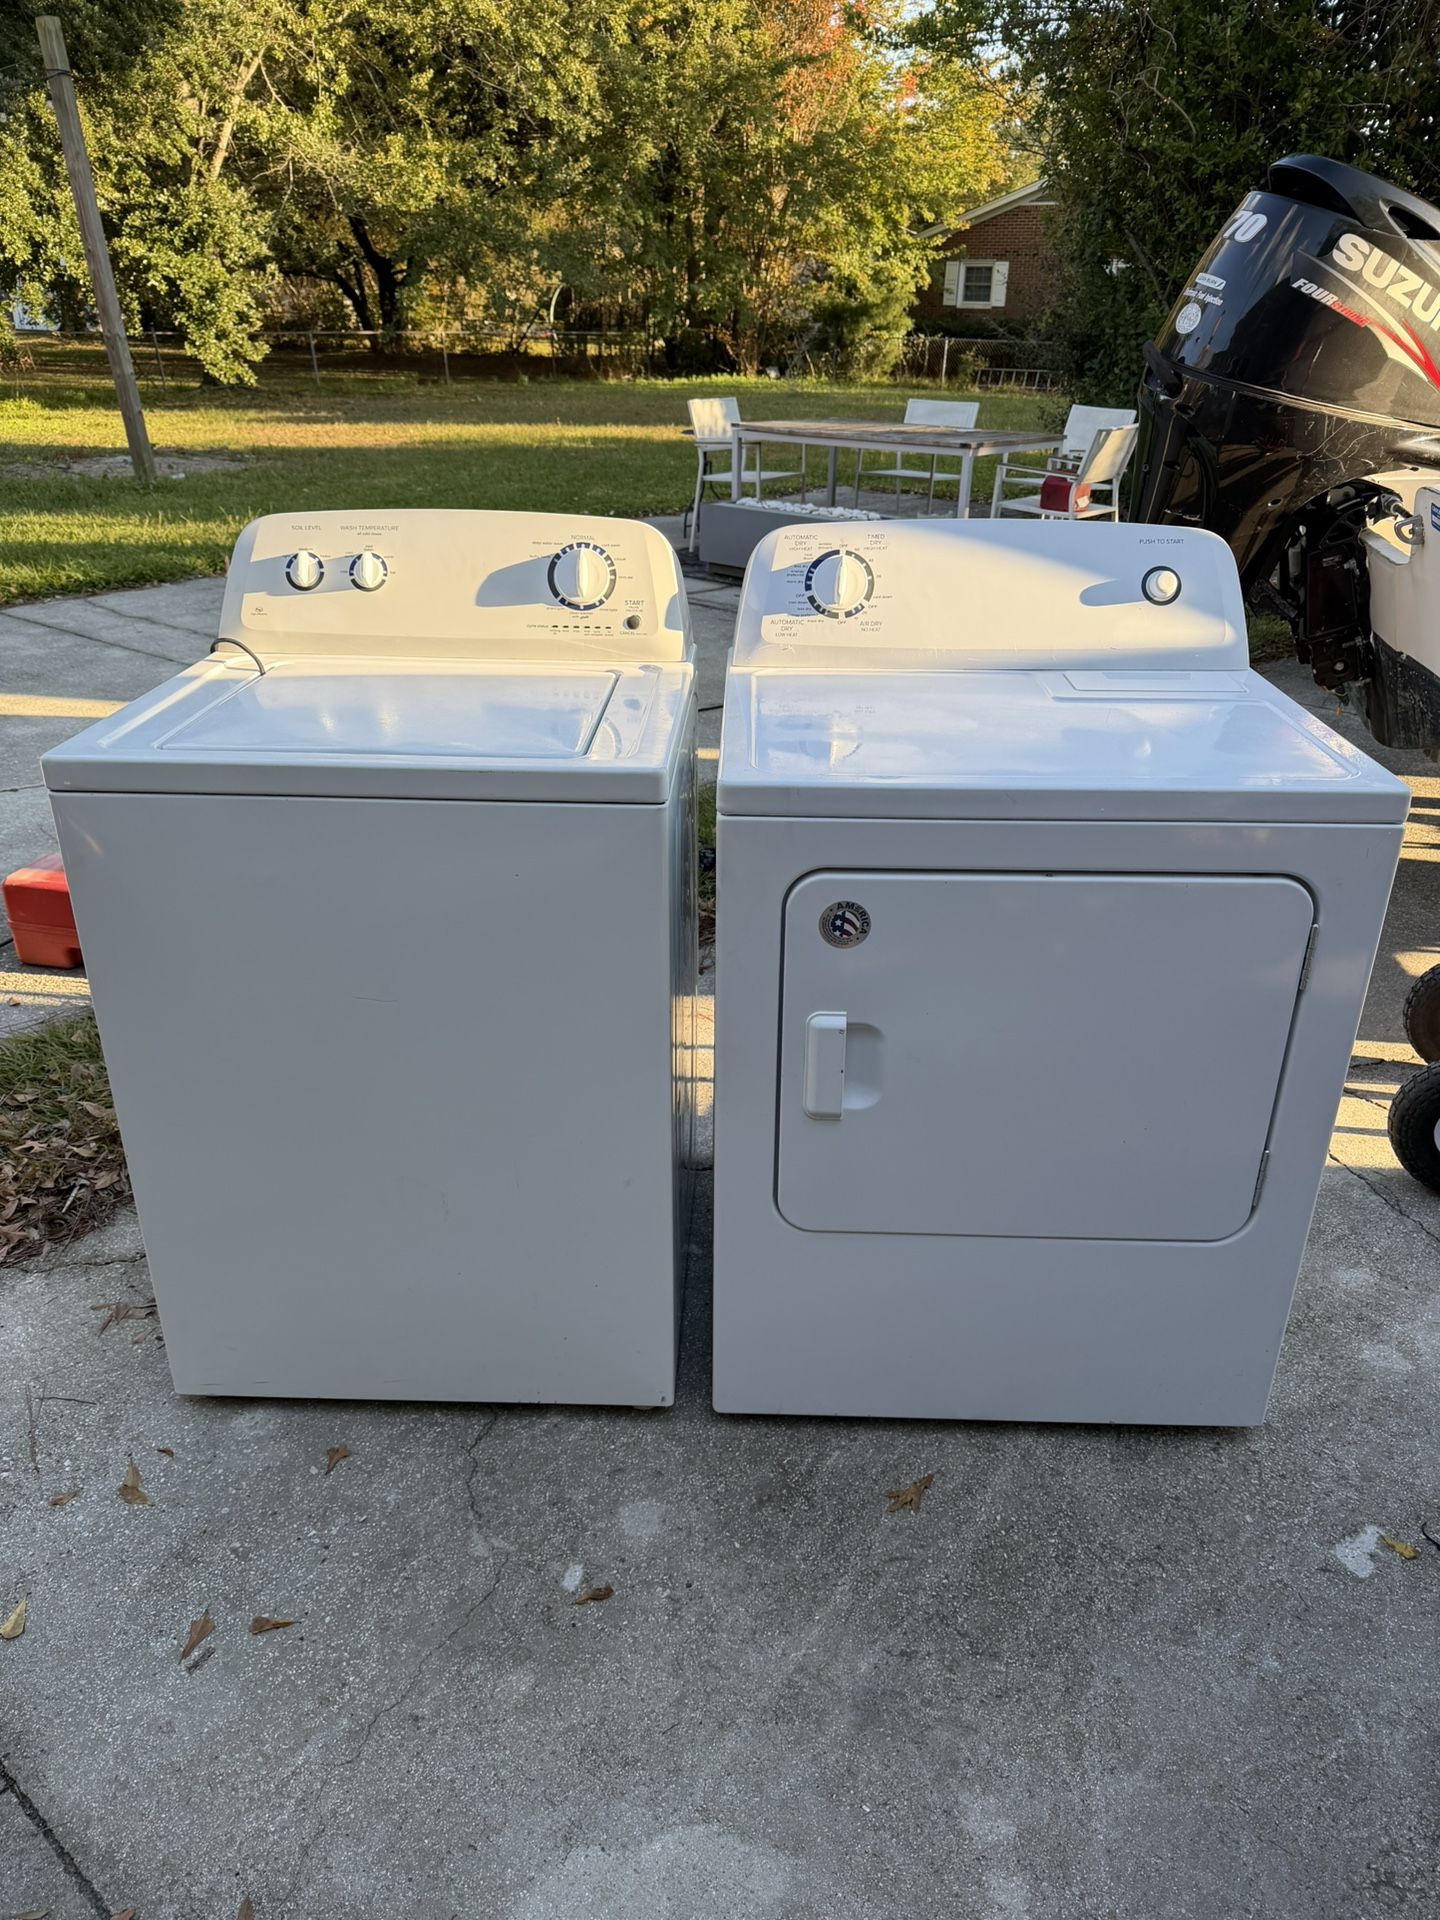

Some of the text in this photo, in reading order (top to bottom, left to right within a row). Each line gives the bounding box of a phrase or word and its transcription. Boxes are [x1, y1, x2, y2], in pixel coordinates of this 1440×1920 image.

[1223, 210, 1267, 243] 70
[1332, 233, 1440, 331] SUZU
[836, 902, 870, 934] AMERICA
